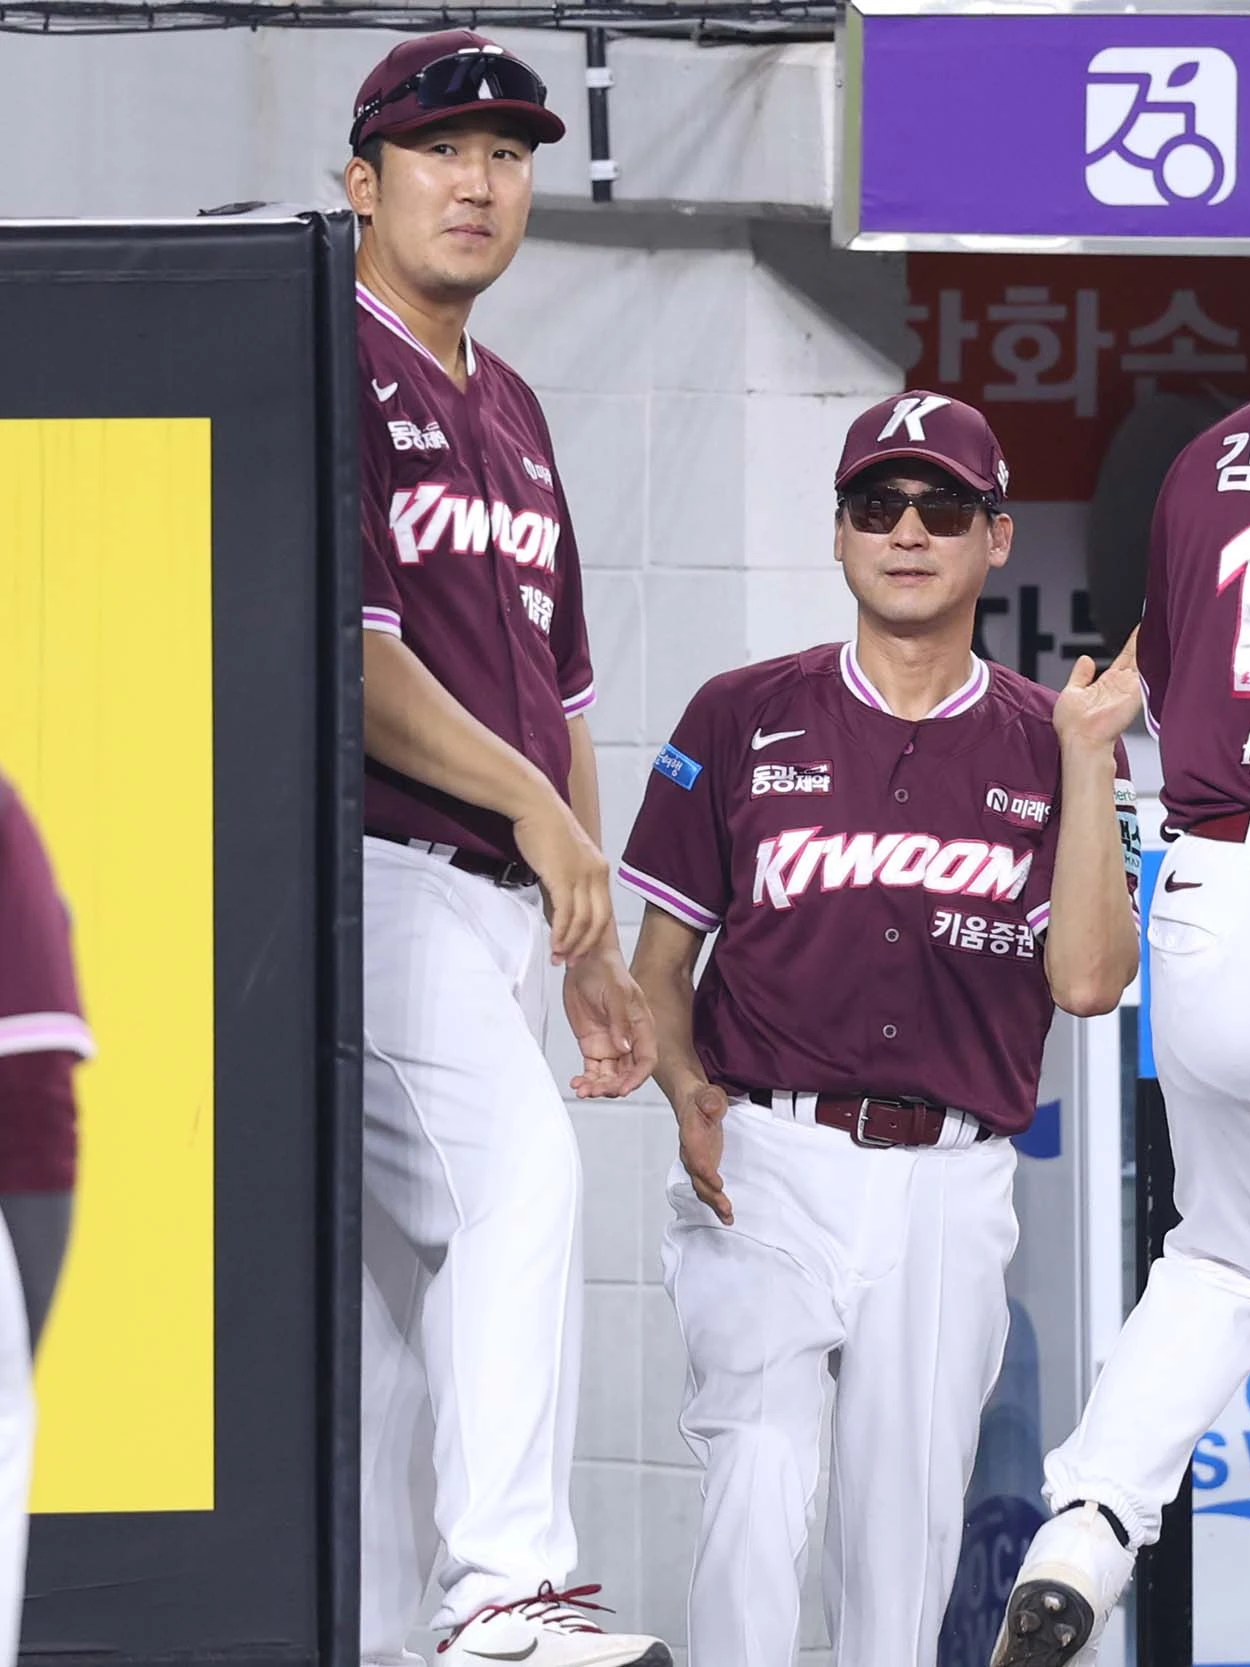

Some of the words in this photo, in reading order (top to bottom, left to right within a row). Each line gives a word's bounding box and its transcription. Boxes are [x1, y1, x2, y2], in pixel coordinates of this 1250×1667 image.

[876, 395, 951, 442] K
[752, 826, 1035, 912] KIWOOM
[931, 911, 1034, 958] 키움증권
